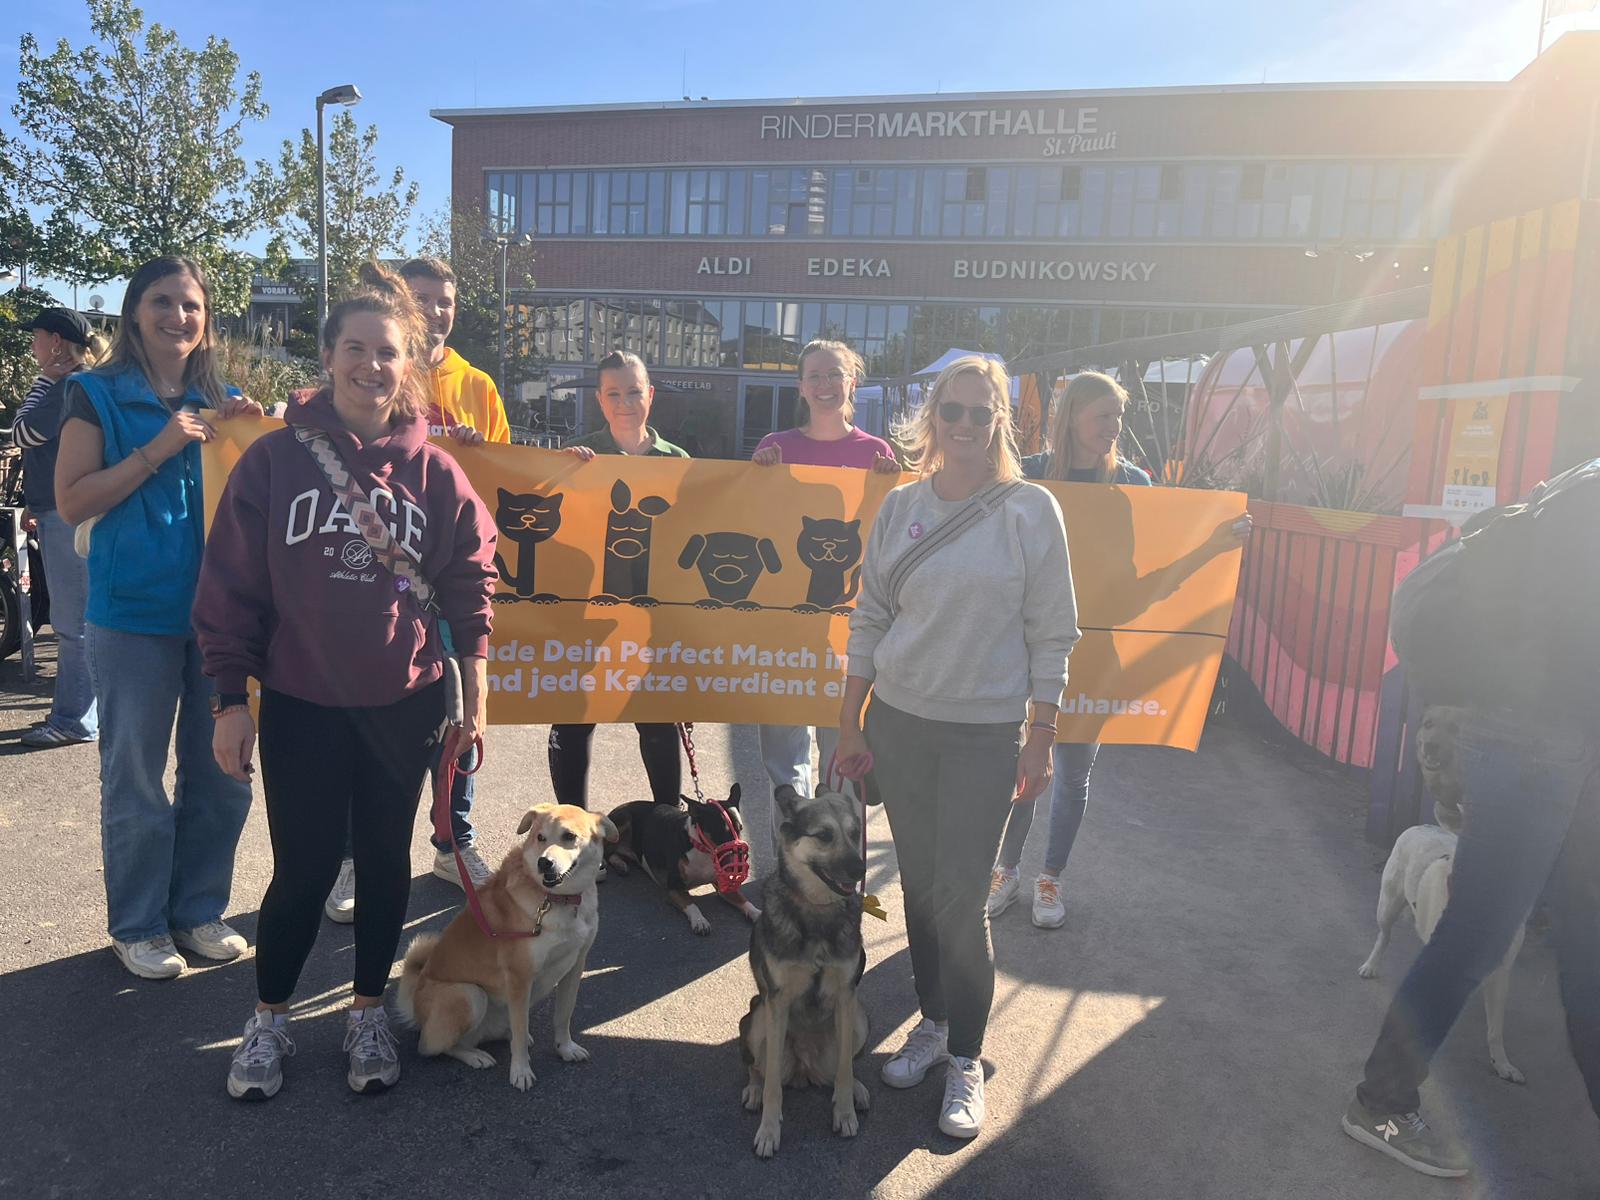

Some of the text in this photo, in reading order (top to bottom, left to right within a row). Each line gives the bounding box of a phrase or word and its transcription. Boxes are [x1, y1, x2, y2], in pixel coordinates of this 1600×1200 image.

[760, 107, 1099, 139] RINDERMARKTHALLE
[1042, 131, 1117, 157] St. Pauli
[697, 256, 751, 275] ALDI
[807, 258, 892, 277] EDEKA
[953, 259, 1157, 281] BUDNIKOWSKY
[544, 639, 612, 663] Dein
[620, 641, 724, 665] Perfect
[731, 644, 817, 669] Match
[486, 667, 848, 698] nd jede Katze verdient ei
[1061, 693, 1168, 716] uhause.
